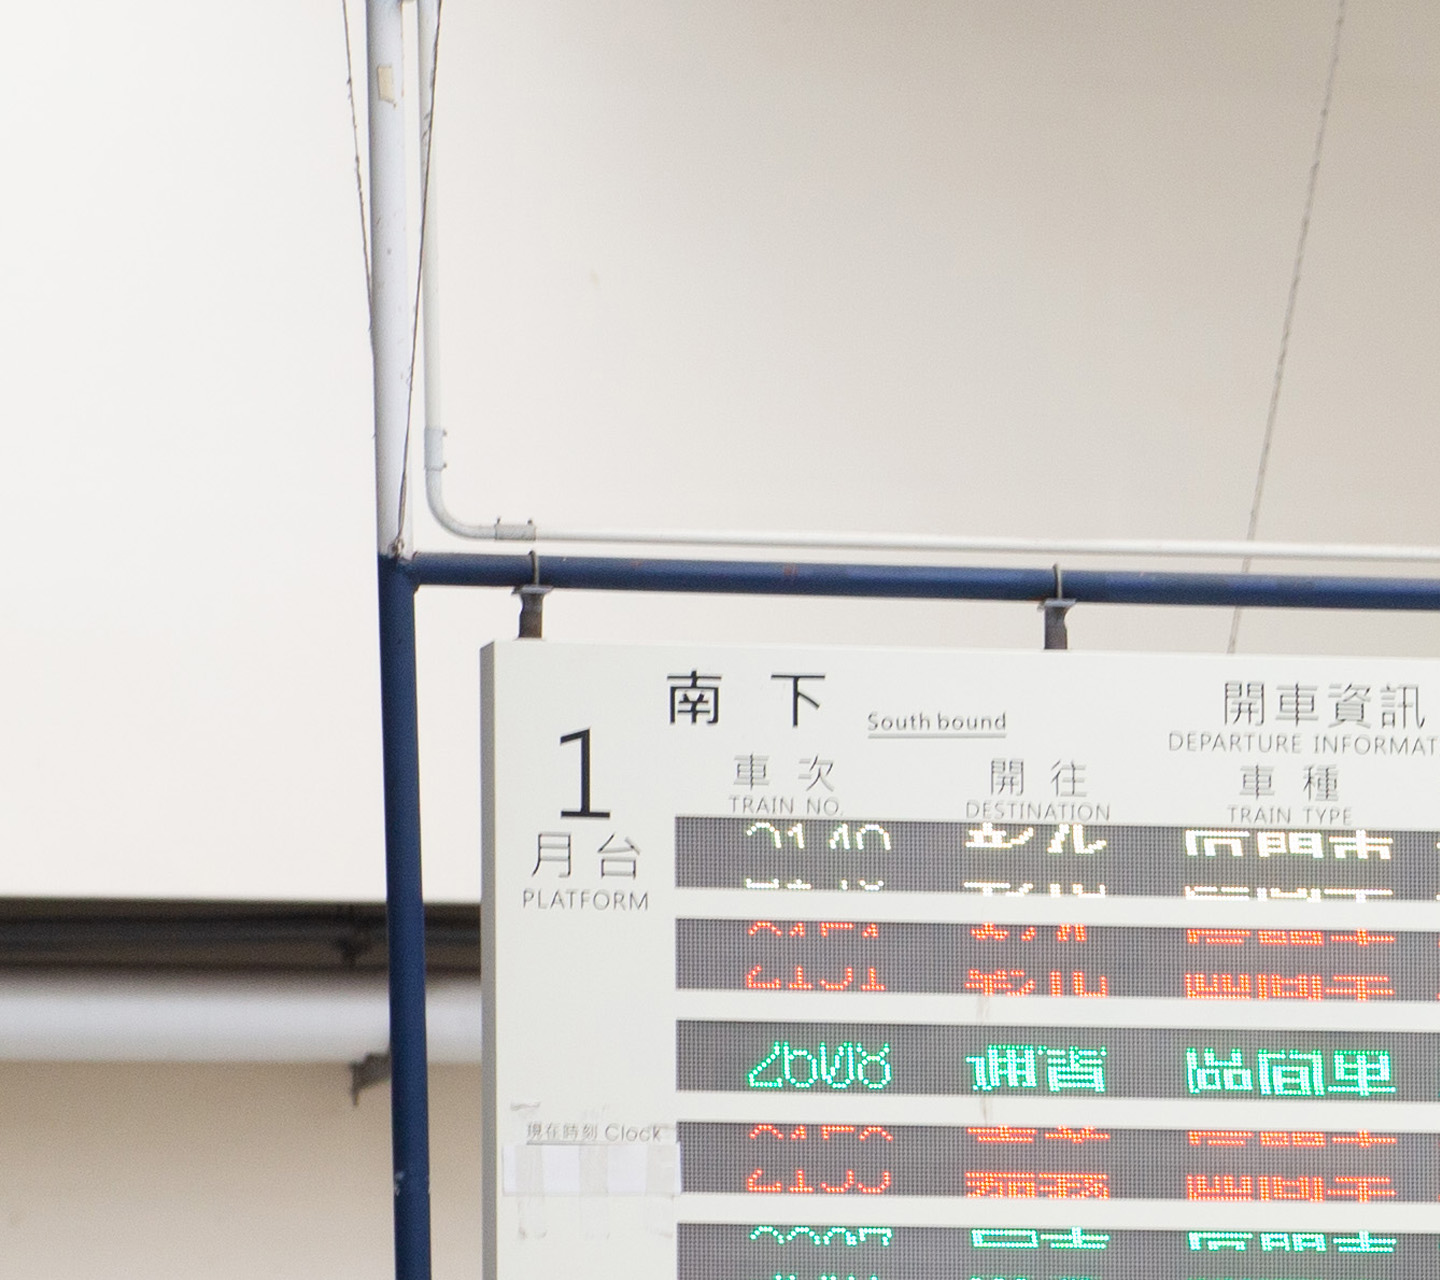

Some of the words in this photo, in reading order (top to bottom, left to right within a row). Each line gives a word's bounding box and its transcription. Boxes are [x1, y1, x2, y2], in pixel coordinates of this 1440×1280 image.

[666, 670, 826, 728] 南下
[1224, 682, 1426, 729] 開車資訊
[867, 712, 931, 730] South
[937, 712, 1006, 730] bound
[1168, 732, 1302, 754] DEPARTURE
[559, 728, 611, 819] 1
[733, 753, 836, 792] 車次
[989, 758, 1088, 797] 開往
[1242, 764, 1338, 801] 車種
[729, 796, 794, 815] TRAIN
[966, 801, 1111, 821] DESTINATION
[1228, 806, 1292, 824] TRAIN
[1306, 807, 1348, 825] TYPE
[531, 833, 640, 879] 月台
[522, 889, 649, 910] PLATFORM
[604, 1122, 663, 1142] Clock
